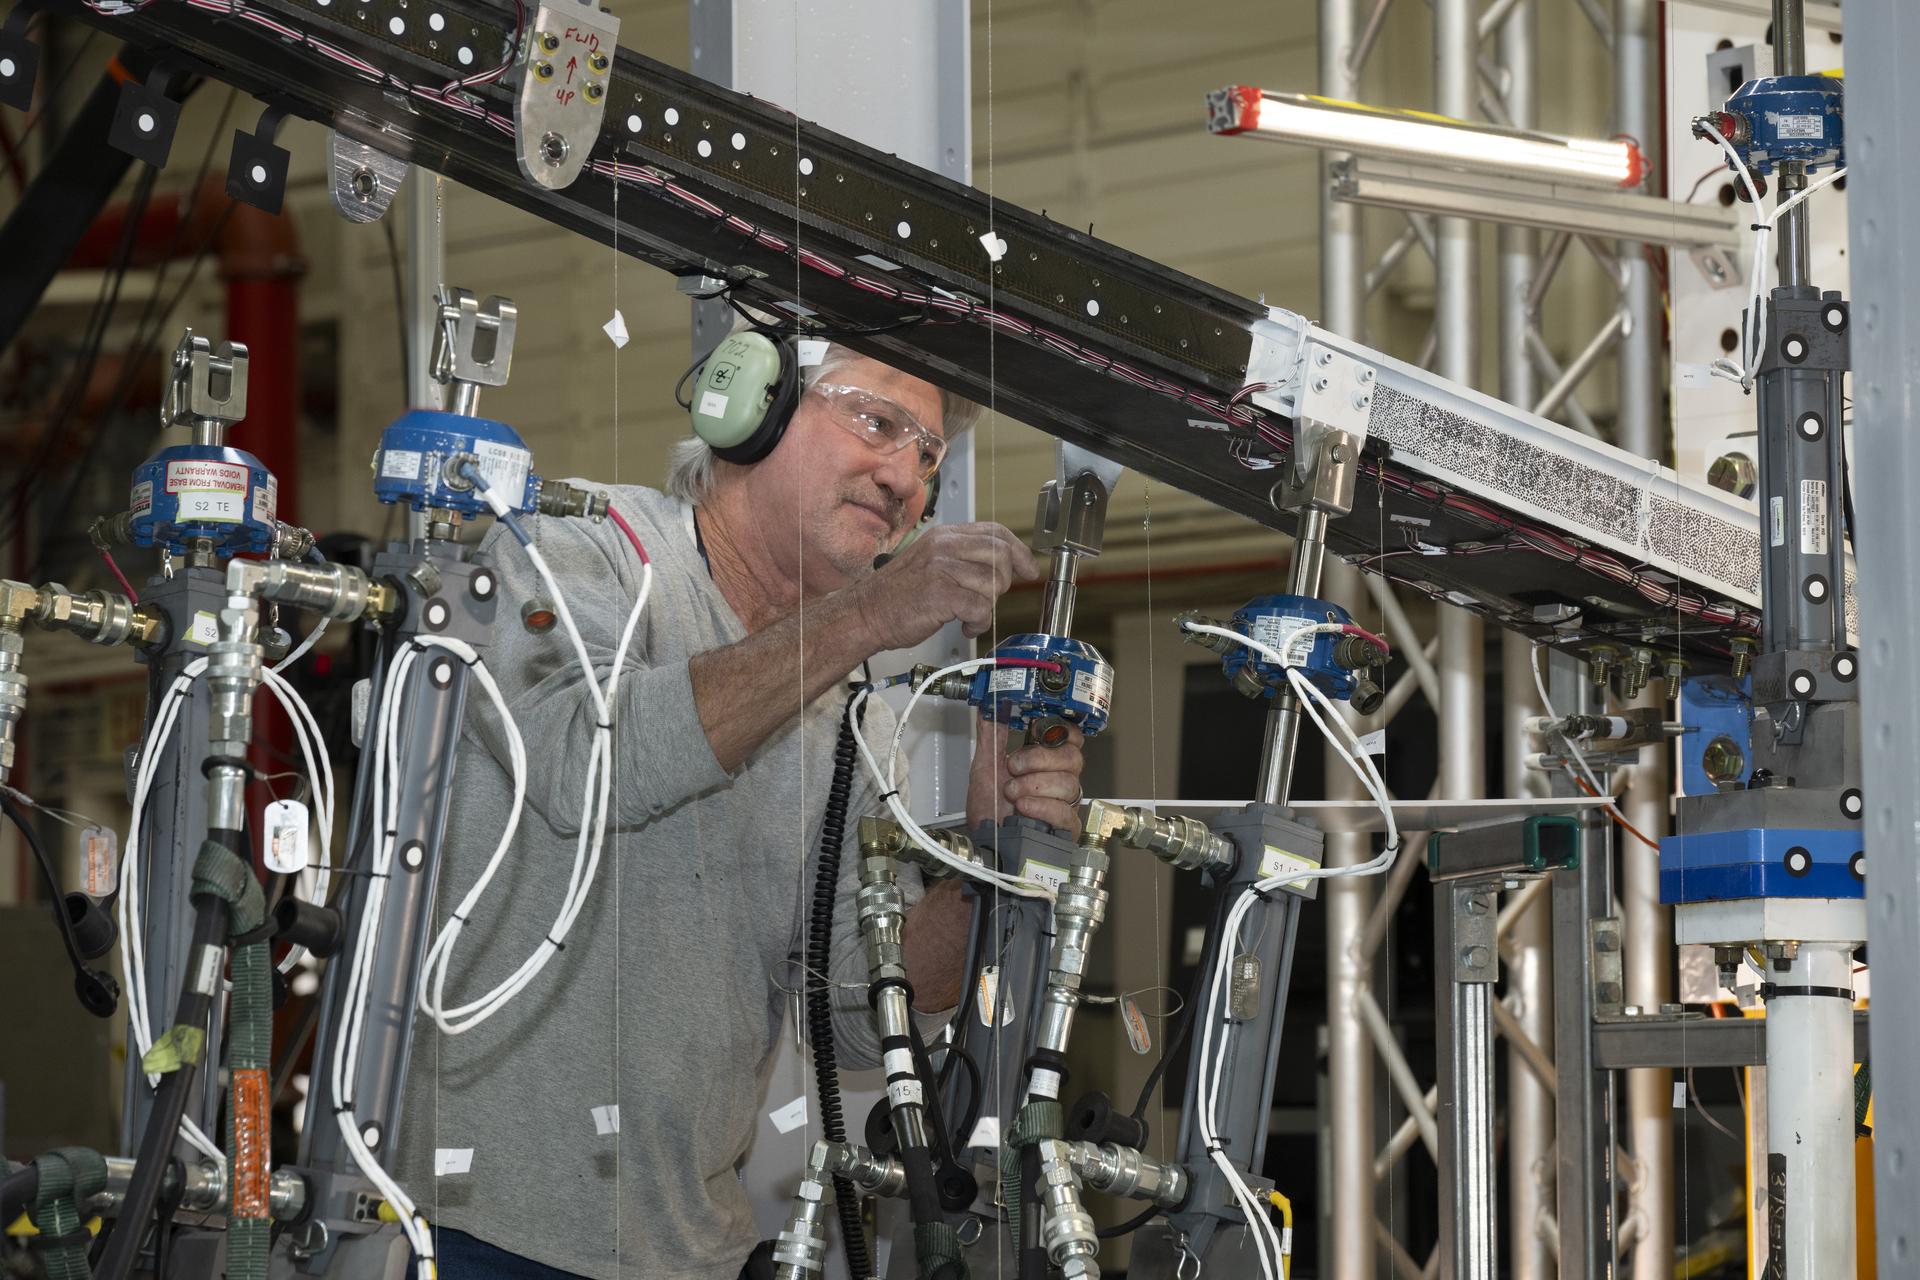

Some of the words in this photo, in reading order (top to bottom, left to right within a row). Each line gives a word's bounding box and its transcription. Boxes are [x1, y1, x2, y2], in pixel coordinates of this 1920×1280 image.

[565, 27, 600, 53] FWD
[175, 467, 217, 475] WARRANTY
[219, 470, 241, 479] VOIDS
[169, 478, 187, 486] BASE
[188, 479, 211, 487] FROM
[212, 480, 246, 492] REMOVAL
[194, 501, 209, 511] S2
[217, 502, 230, 511] TE
[204, 626, 217, 639] S2
[1273, 861, 1284, 872] S1
[1049, 877, 1058, 887] TE
